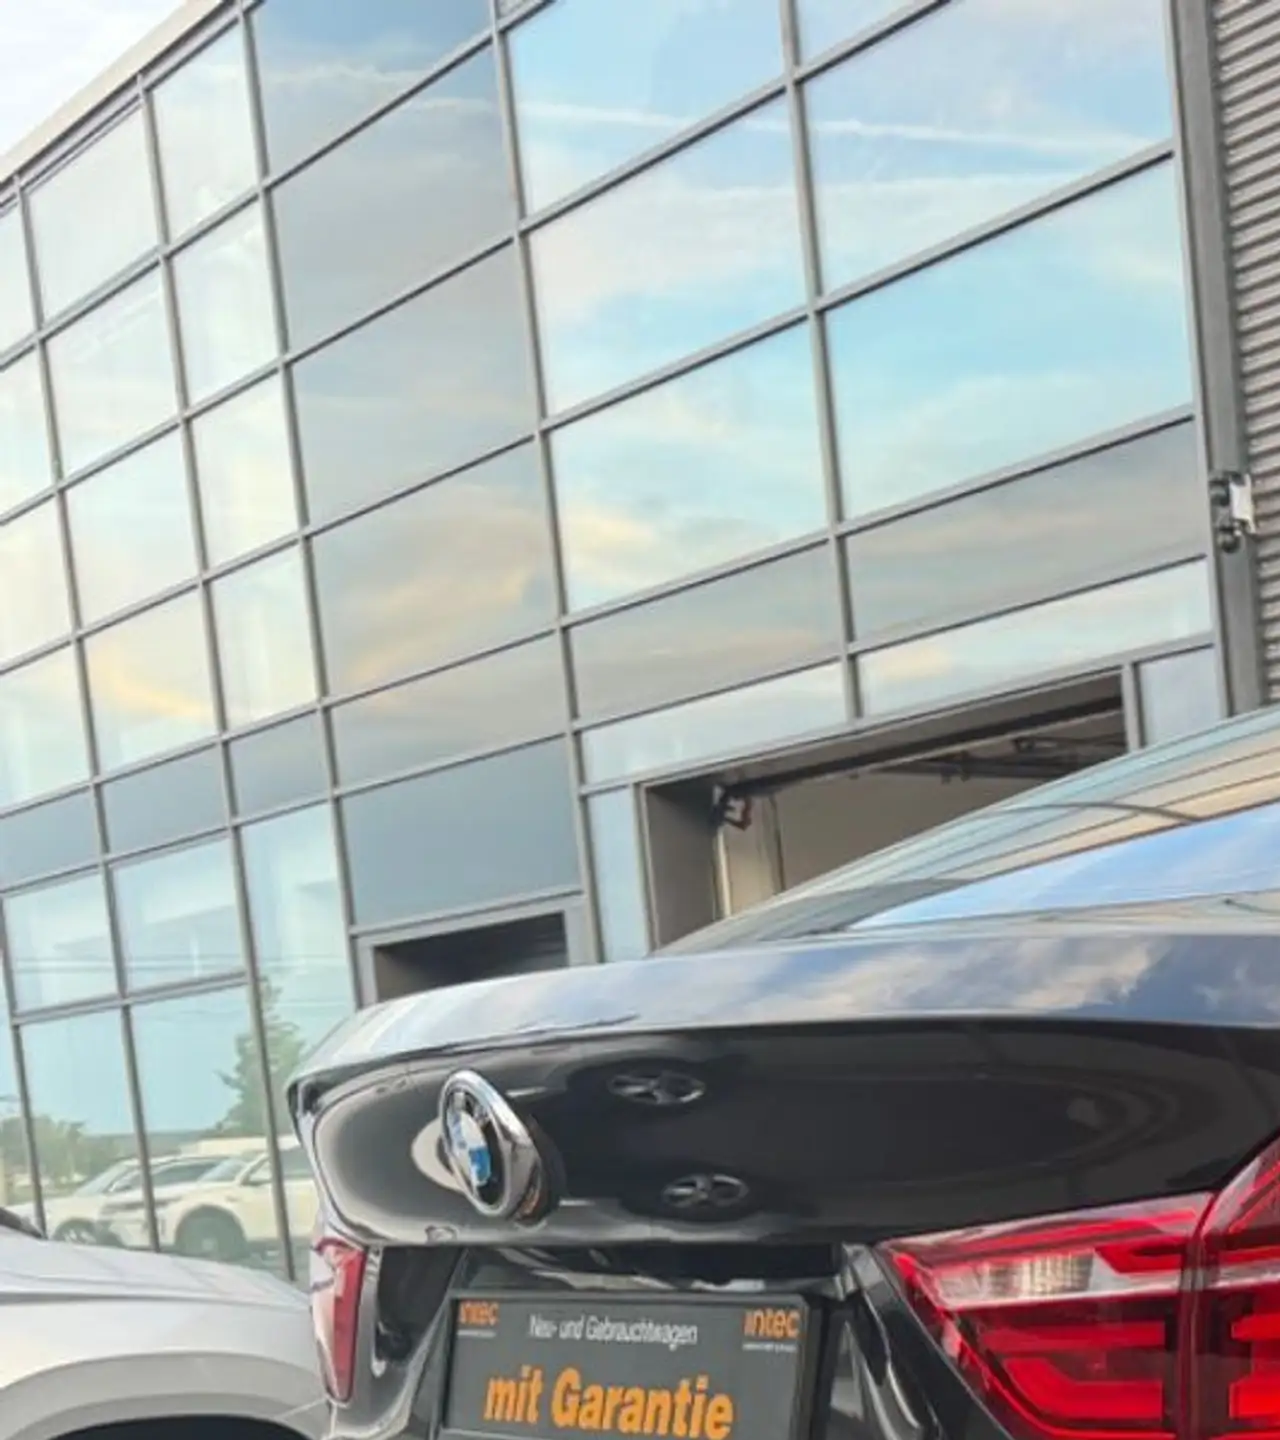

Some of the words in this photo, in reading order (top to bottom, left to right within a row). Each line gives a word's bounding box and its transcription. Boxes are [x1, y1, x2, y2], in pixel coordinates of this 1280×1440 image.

[529, 1313, 557, 1338] Neu-
[559, 1314, 585, 1340] und
[586, 1315, 698, 1351] Gebrauchtwagen
[484, 1364, 543, 1423] mit
